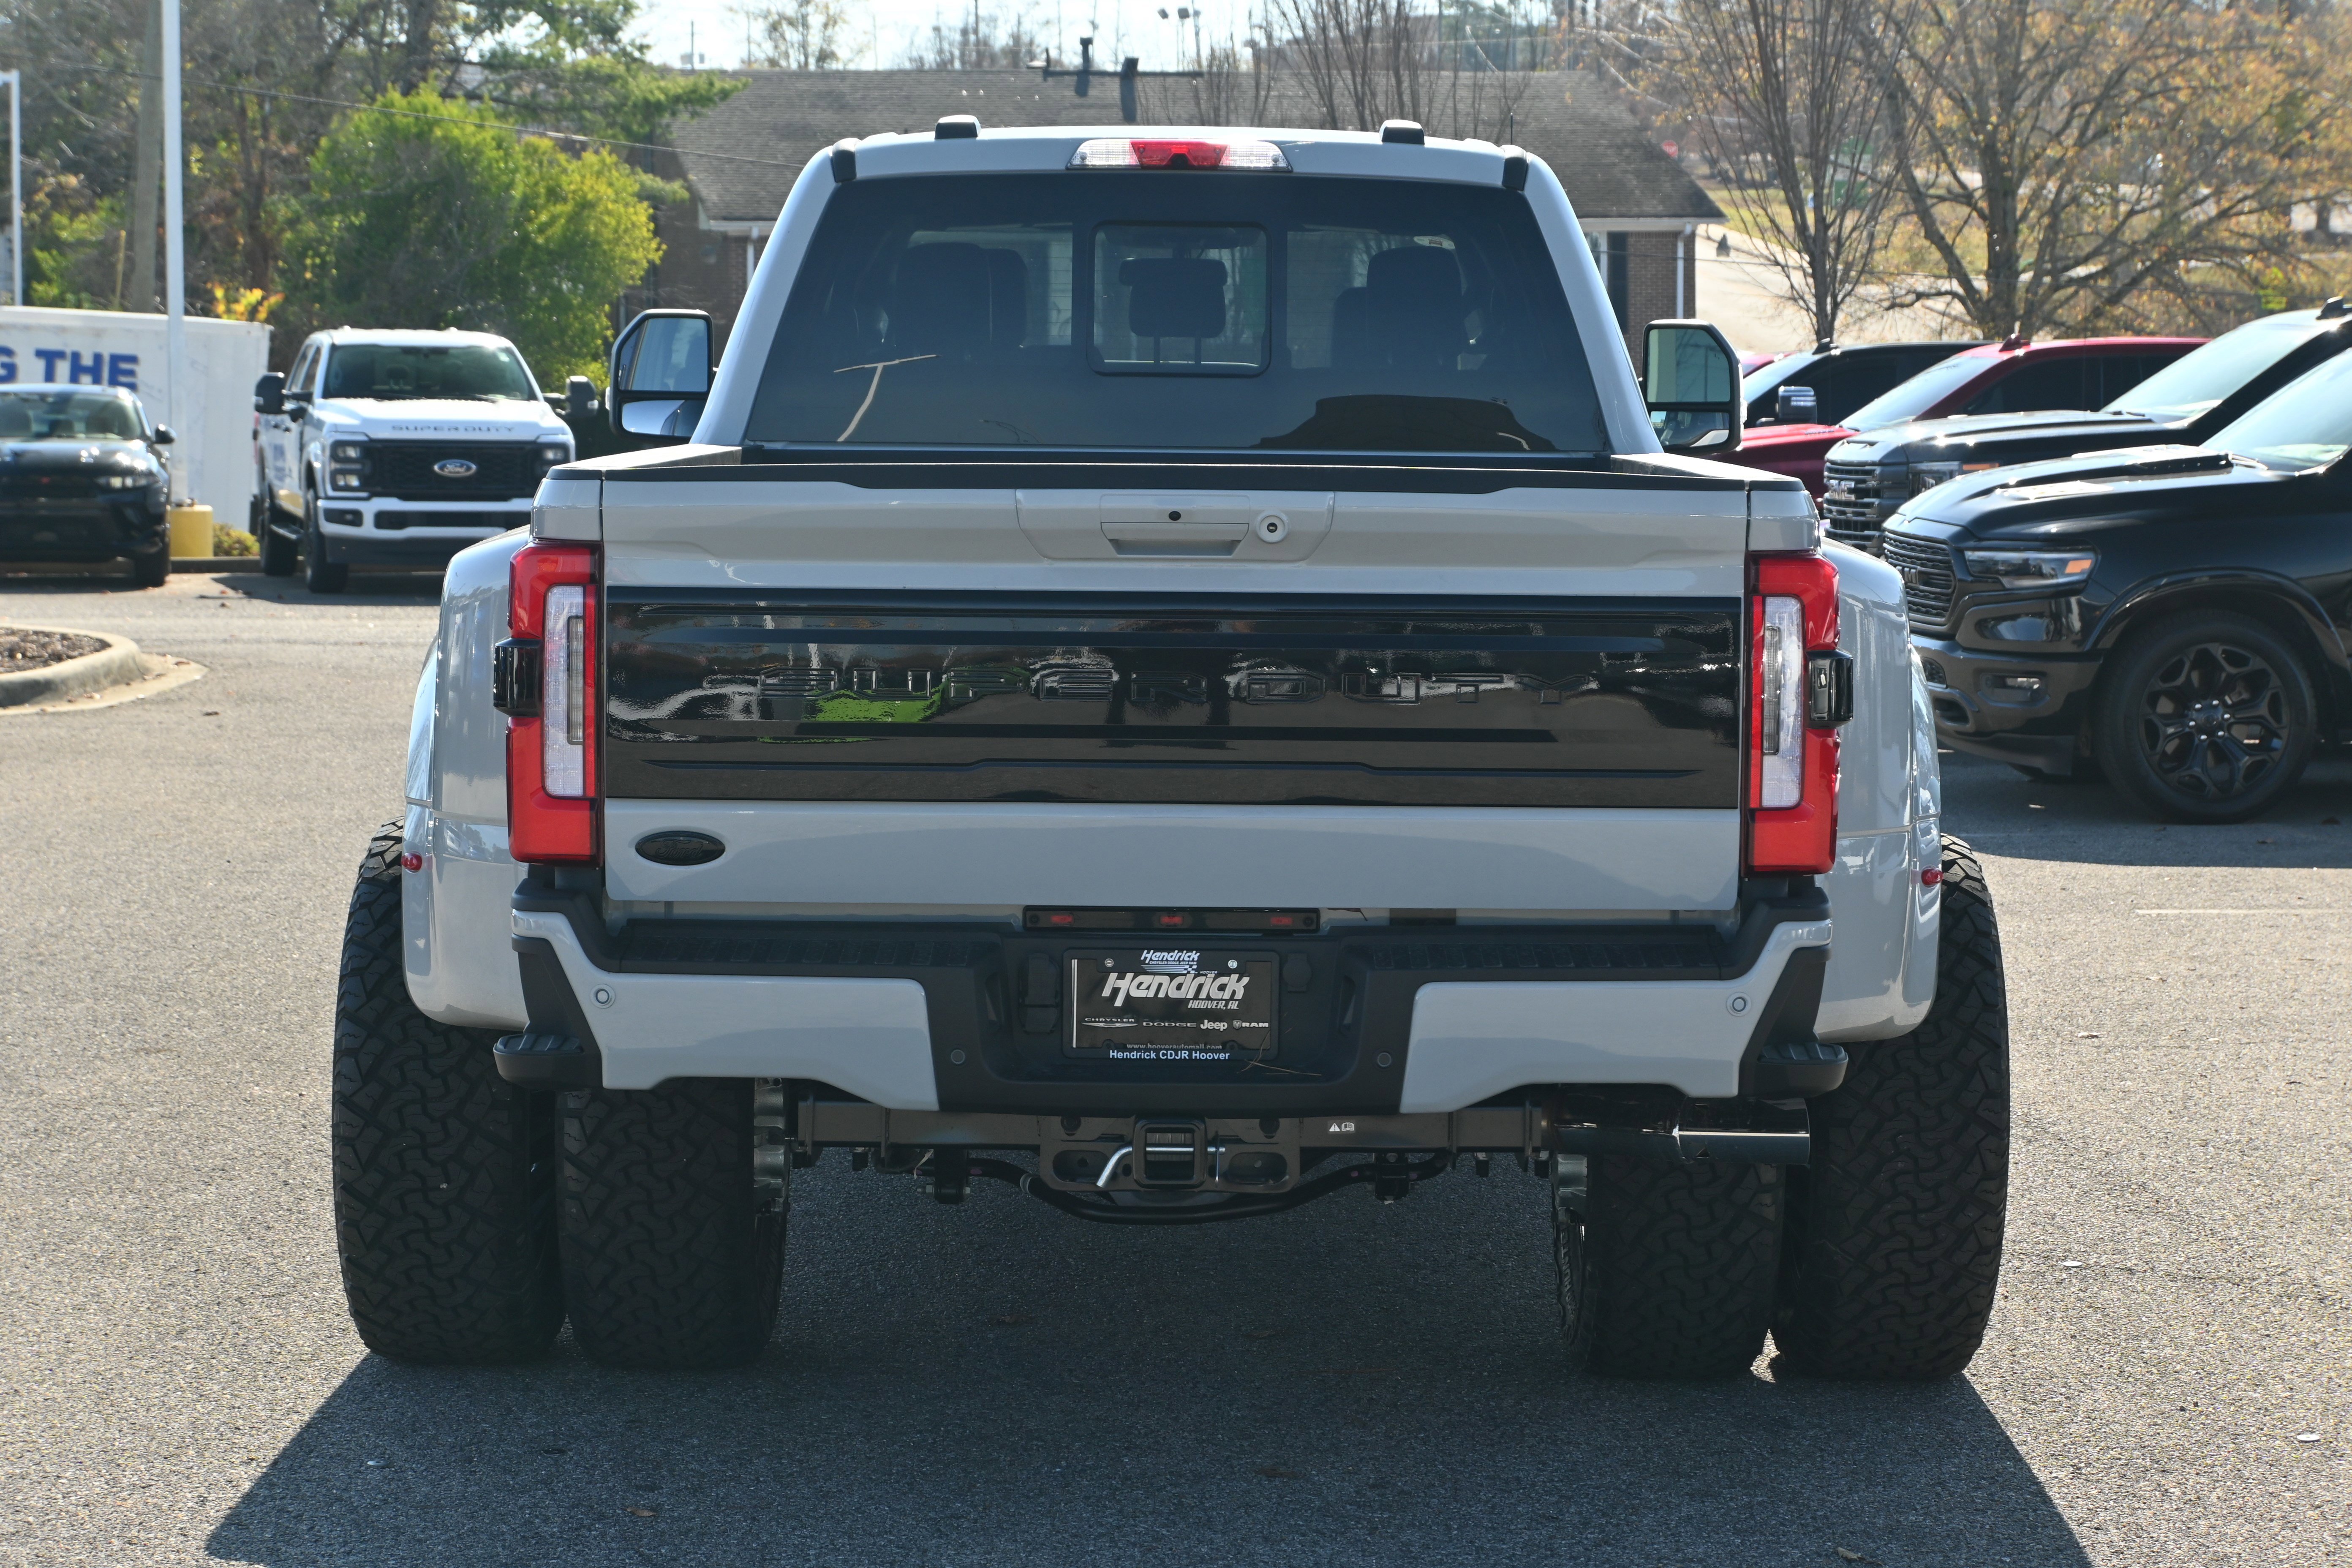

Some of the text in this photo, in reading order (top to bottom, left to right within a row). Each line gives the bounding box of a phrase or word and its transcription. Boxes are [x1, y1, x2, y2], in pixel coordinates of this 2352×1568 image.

[35, 347, 139, 392] THE
[444, 463, 466, 472] Ford
[655, 838, 704, 859] Ford
[1141, 950, 1200, 964] Hendrick
[1101, 972, 1250, 1007] Hendrick
[1187, 999, 1239, 1010] HOOVER, AL
[1200, 1019, 1228, 1031] Jeep
[1109, 1050, 1230, 1060] Hendrick CDJR Hoover
[1560, 1231, 1571, 1292] HUNTE
